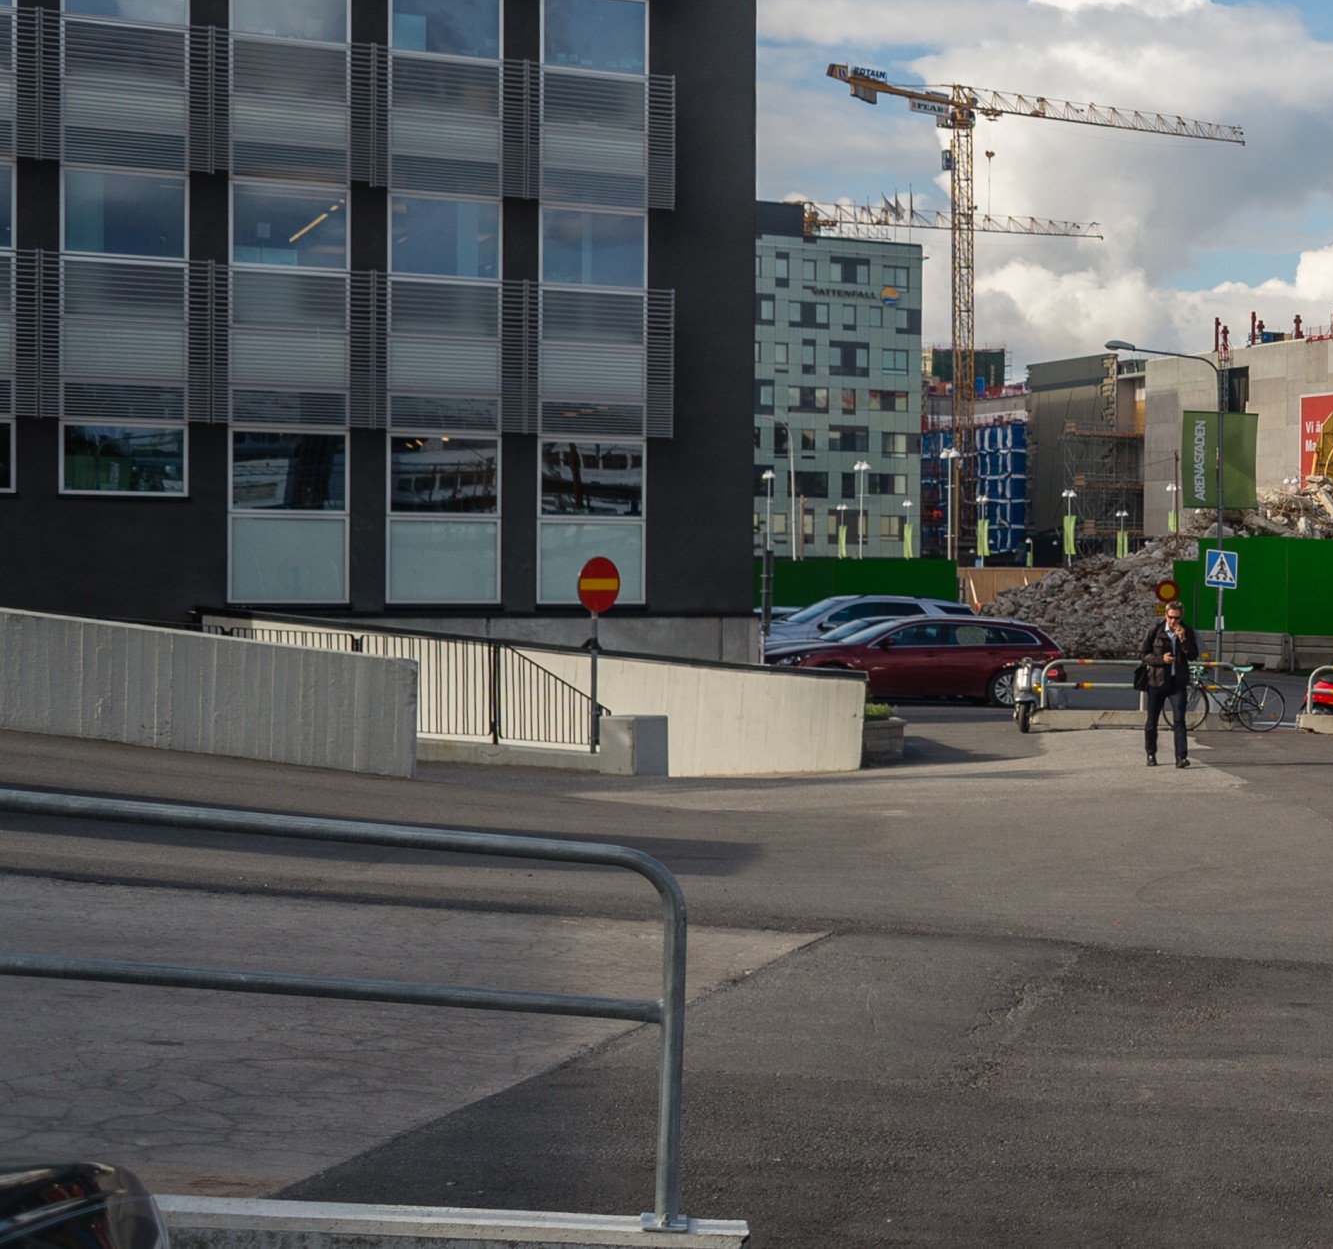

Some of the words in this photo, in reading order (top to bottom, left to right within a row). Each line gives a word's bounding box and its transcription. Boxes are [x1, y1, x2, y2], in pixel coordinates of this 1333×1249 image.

[852, 66, 887, 79] POTAIN
[916, 101, 944, 113] PEAB
[802, 285, 877, 300] VATTENFALL
[1305, 421, 1314, 433] Vi
[1193, 419, 1207, 502] ARENASTADEN
